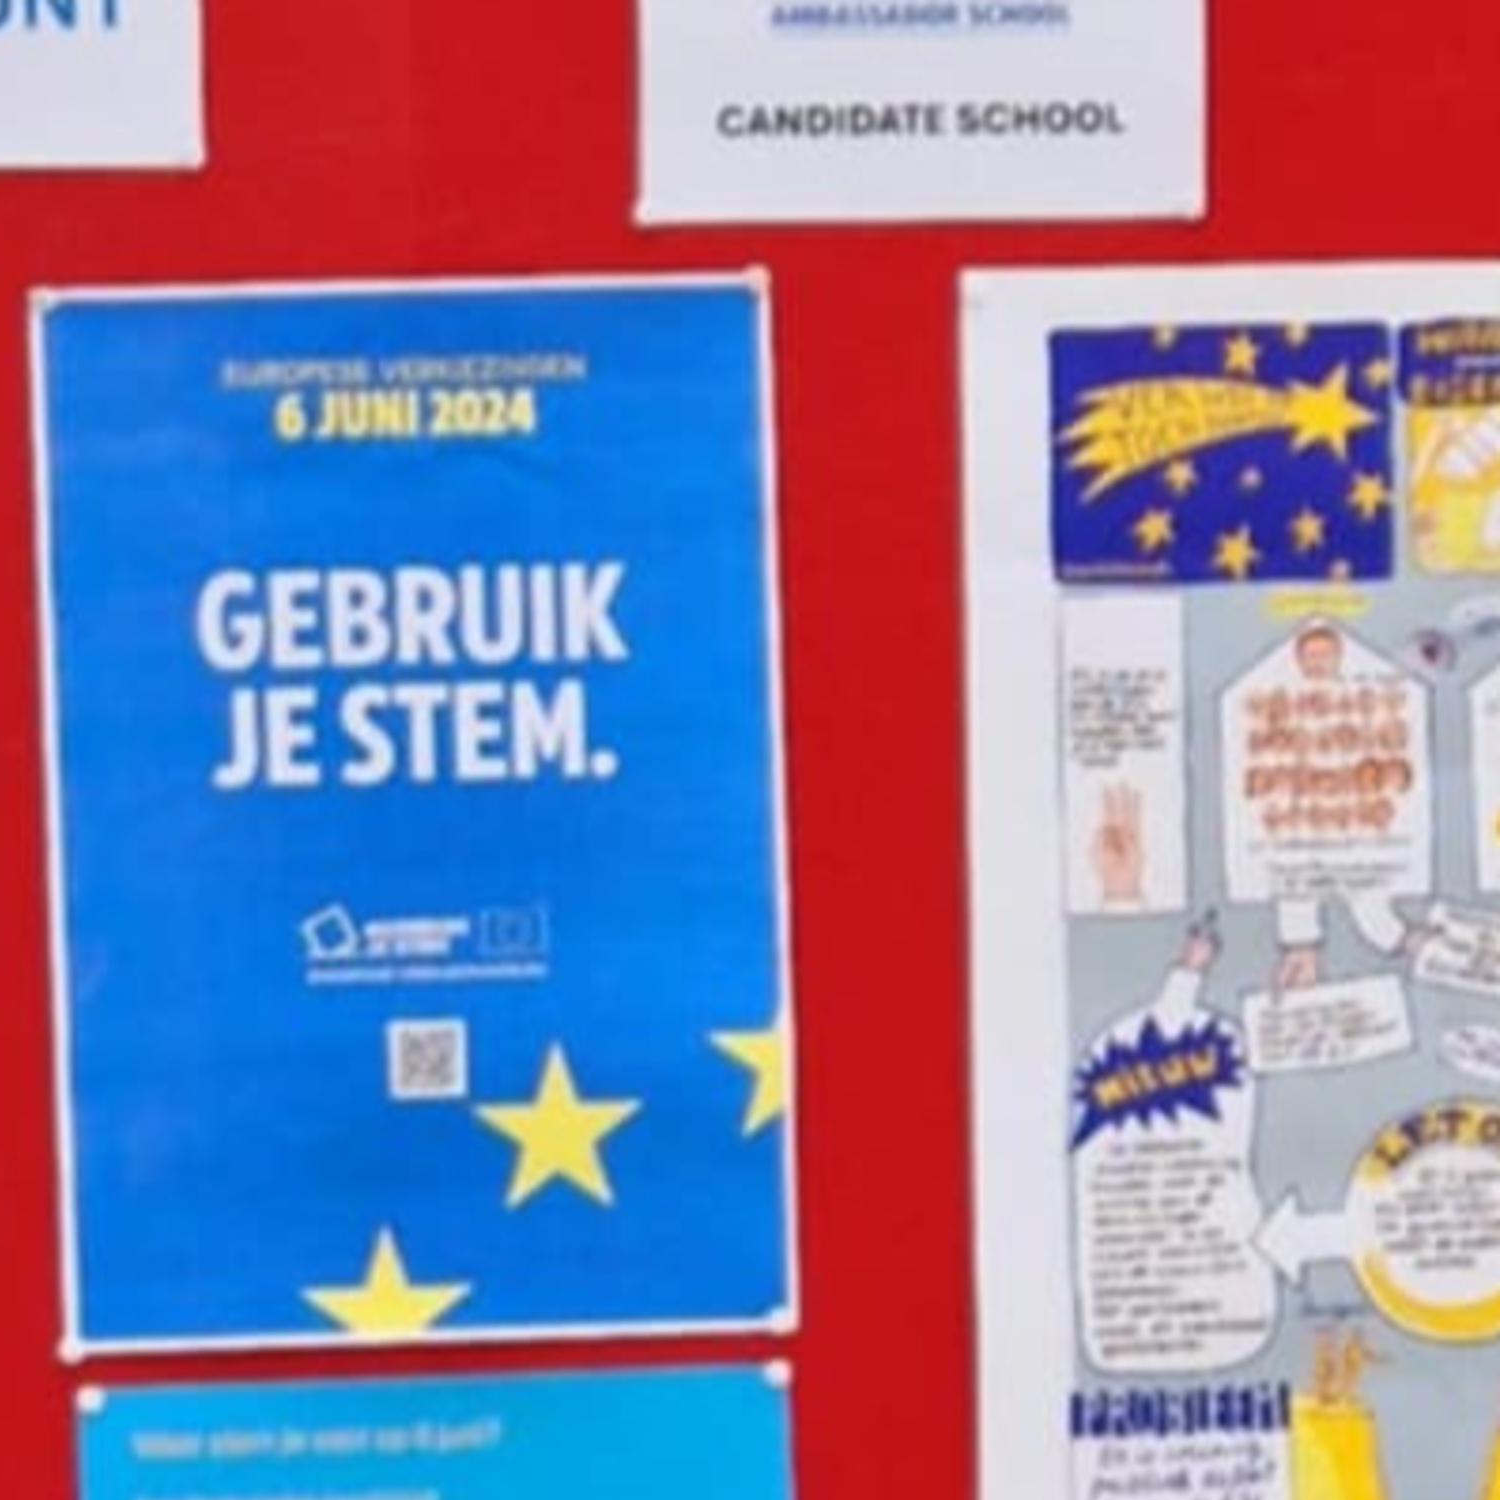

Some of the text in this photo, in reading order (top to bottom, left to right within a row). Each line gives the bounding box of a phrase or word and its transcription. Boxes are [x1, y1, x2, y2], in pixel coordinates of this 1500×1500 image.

[968, 1, 1070, 27] SCHOOL
[716, 102, 1126, 138] CANDIDATE SCHOOL
[274, 387, 537, 439] 6 JUNI 2024
[198, 561, 630, 672] GEBRUIK
[212, 678, 619, 790] JE STEM.
